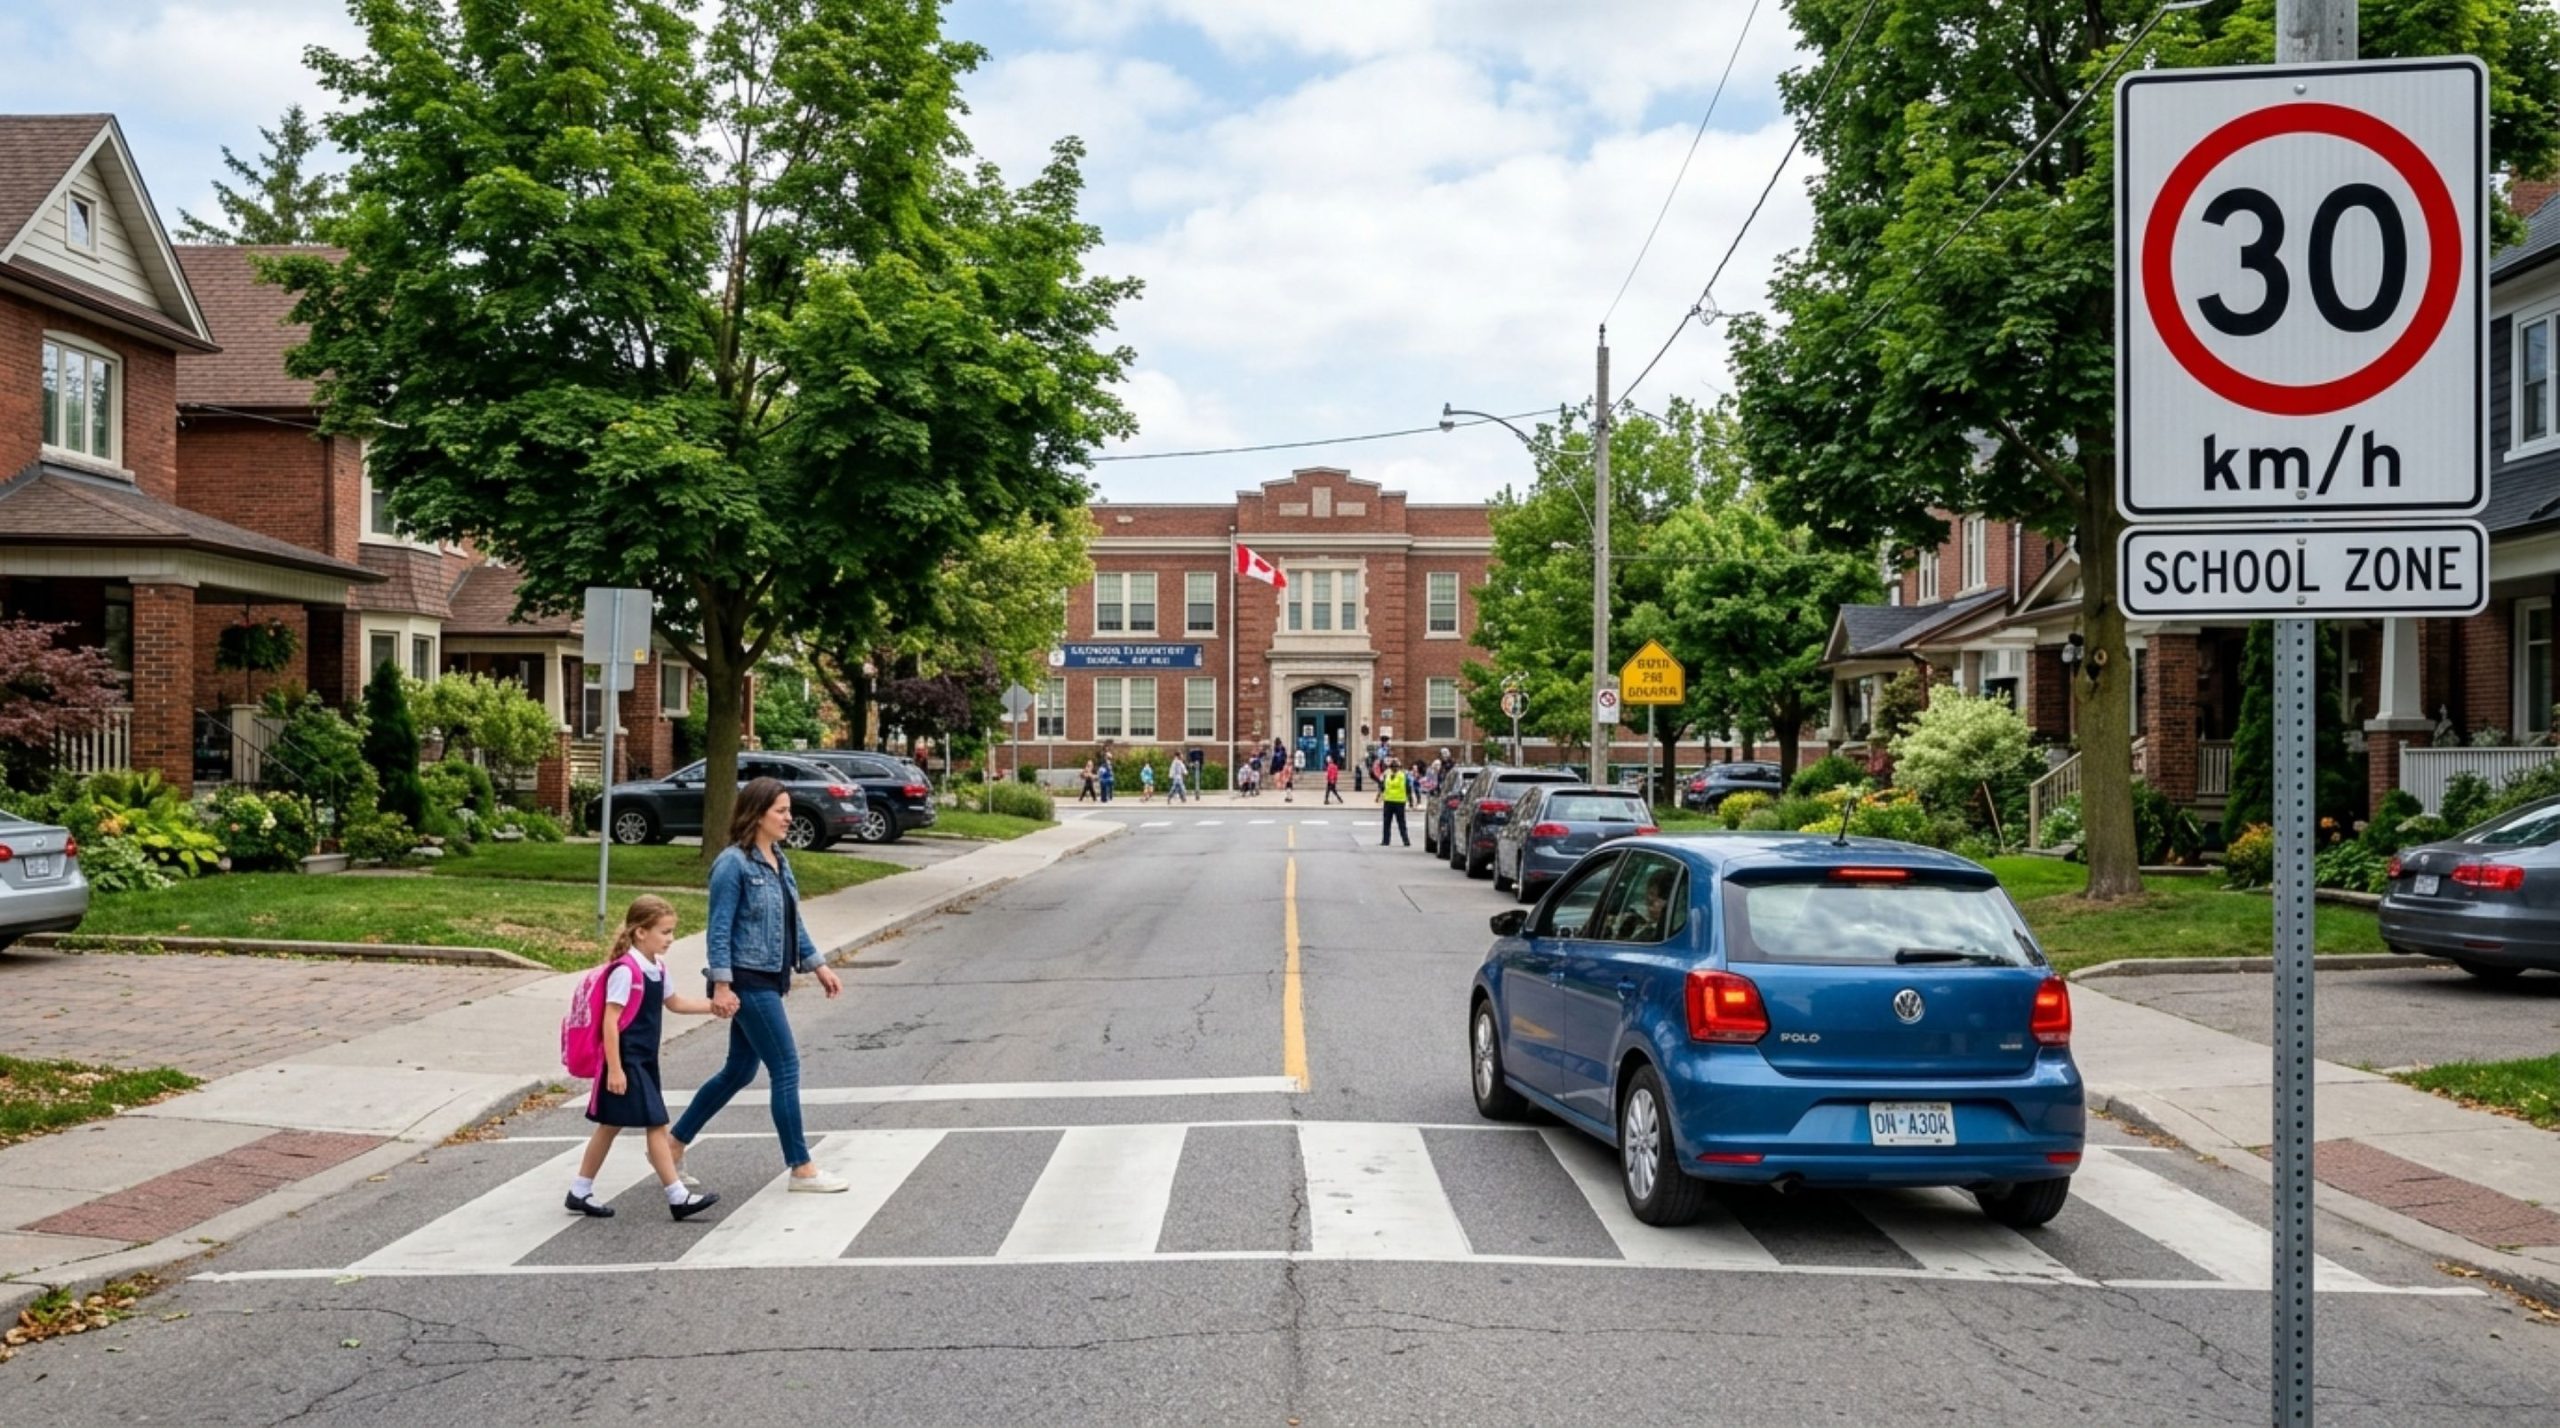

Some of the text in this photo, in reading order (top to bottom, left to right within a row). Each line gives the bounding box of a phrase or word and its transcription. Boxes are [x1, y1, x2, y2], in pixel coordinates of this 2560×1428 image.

[2196, 182, 2408, 337] 30
[2203, 424, 2401, 496] km/h
[2143, 545, 2463, 595] SCHOOL ZONE
[1780, 1032, 1821, 1043] POLO
